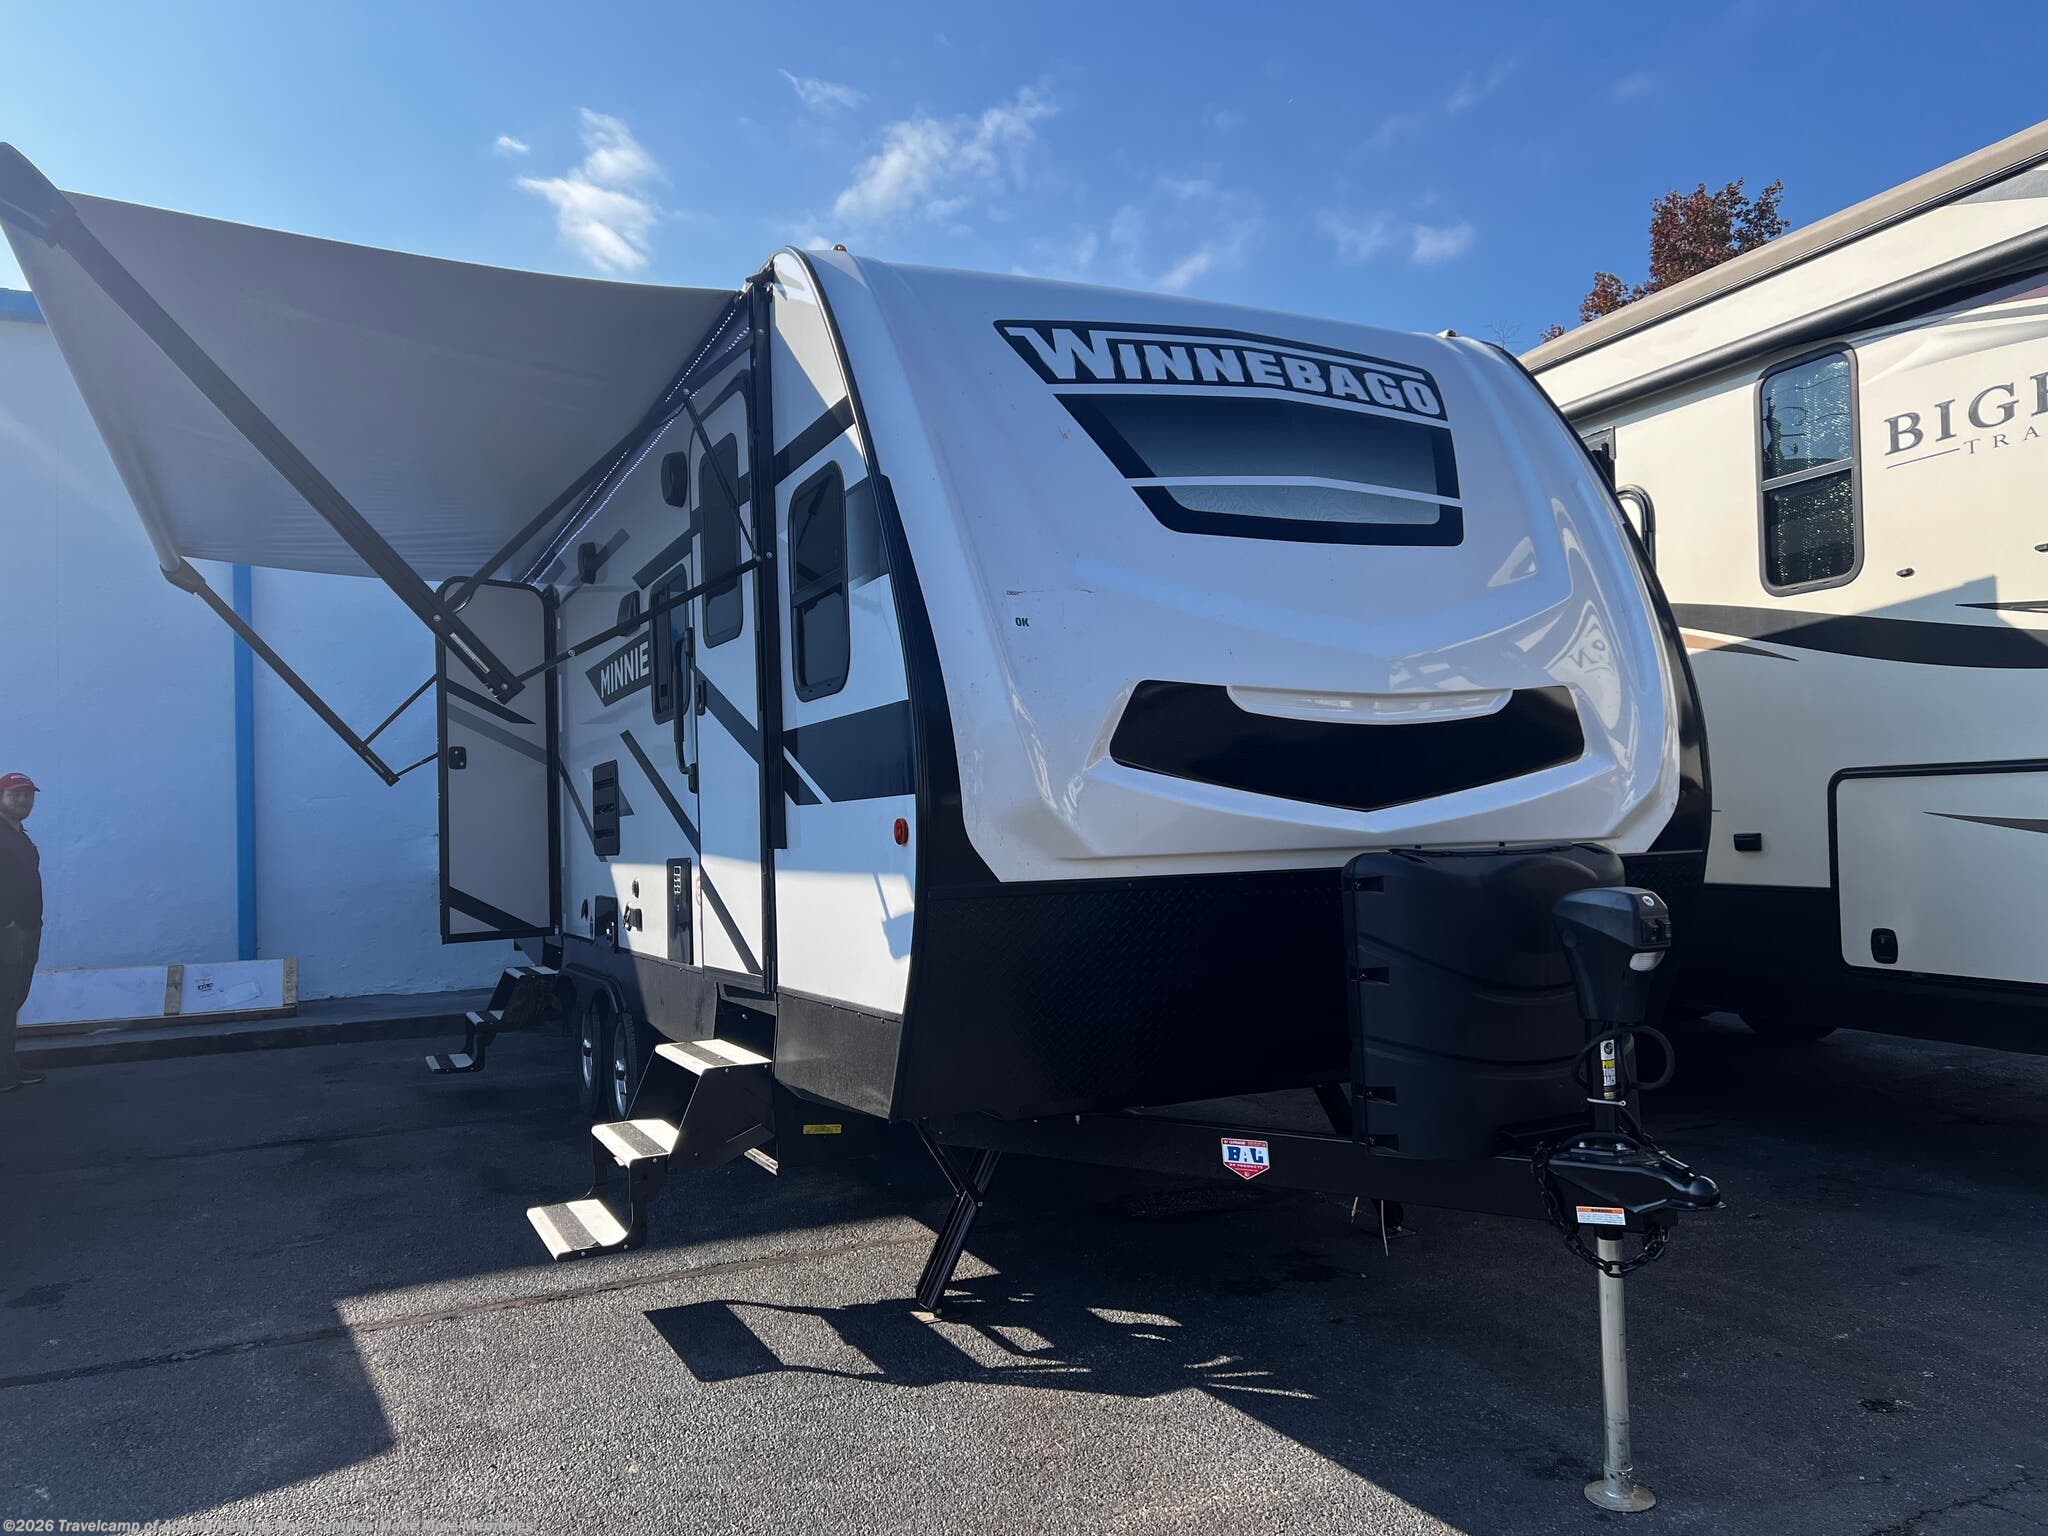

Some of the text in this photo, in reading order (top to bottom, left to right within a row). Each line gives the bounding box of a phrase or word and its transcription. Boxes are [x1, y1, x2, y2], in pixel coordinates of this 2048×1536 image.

[1004, 327, 1441, 416] WINNEBAGO
[1963, 425, 2040, 455] TRA
[1015, 617, 1030, 627] OK
[600, 641, 650, 698] MINNIE
[1227, 1146, 1264, 1164] BAL
